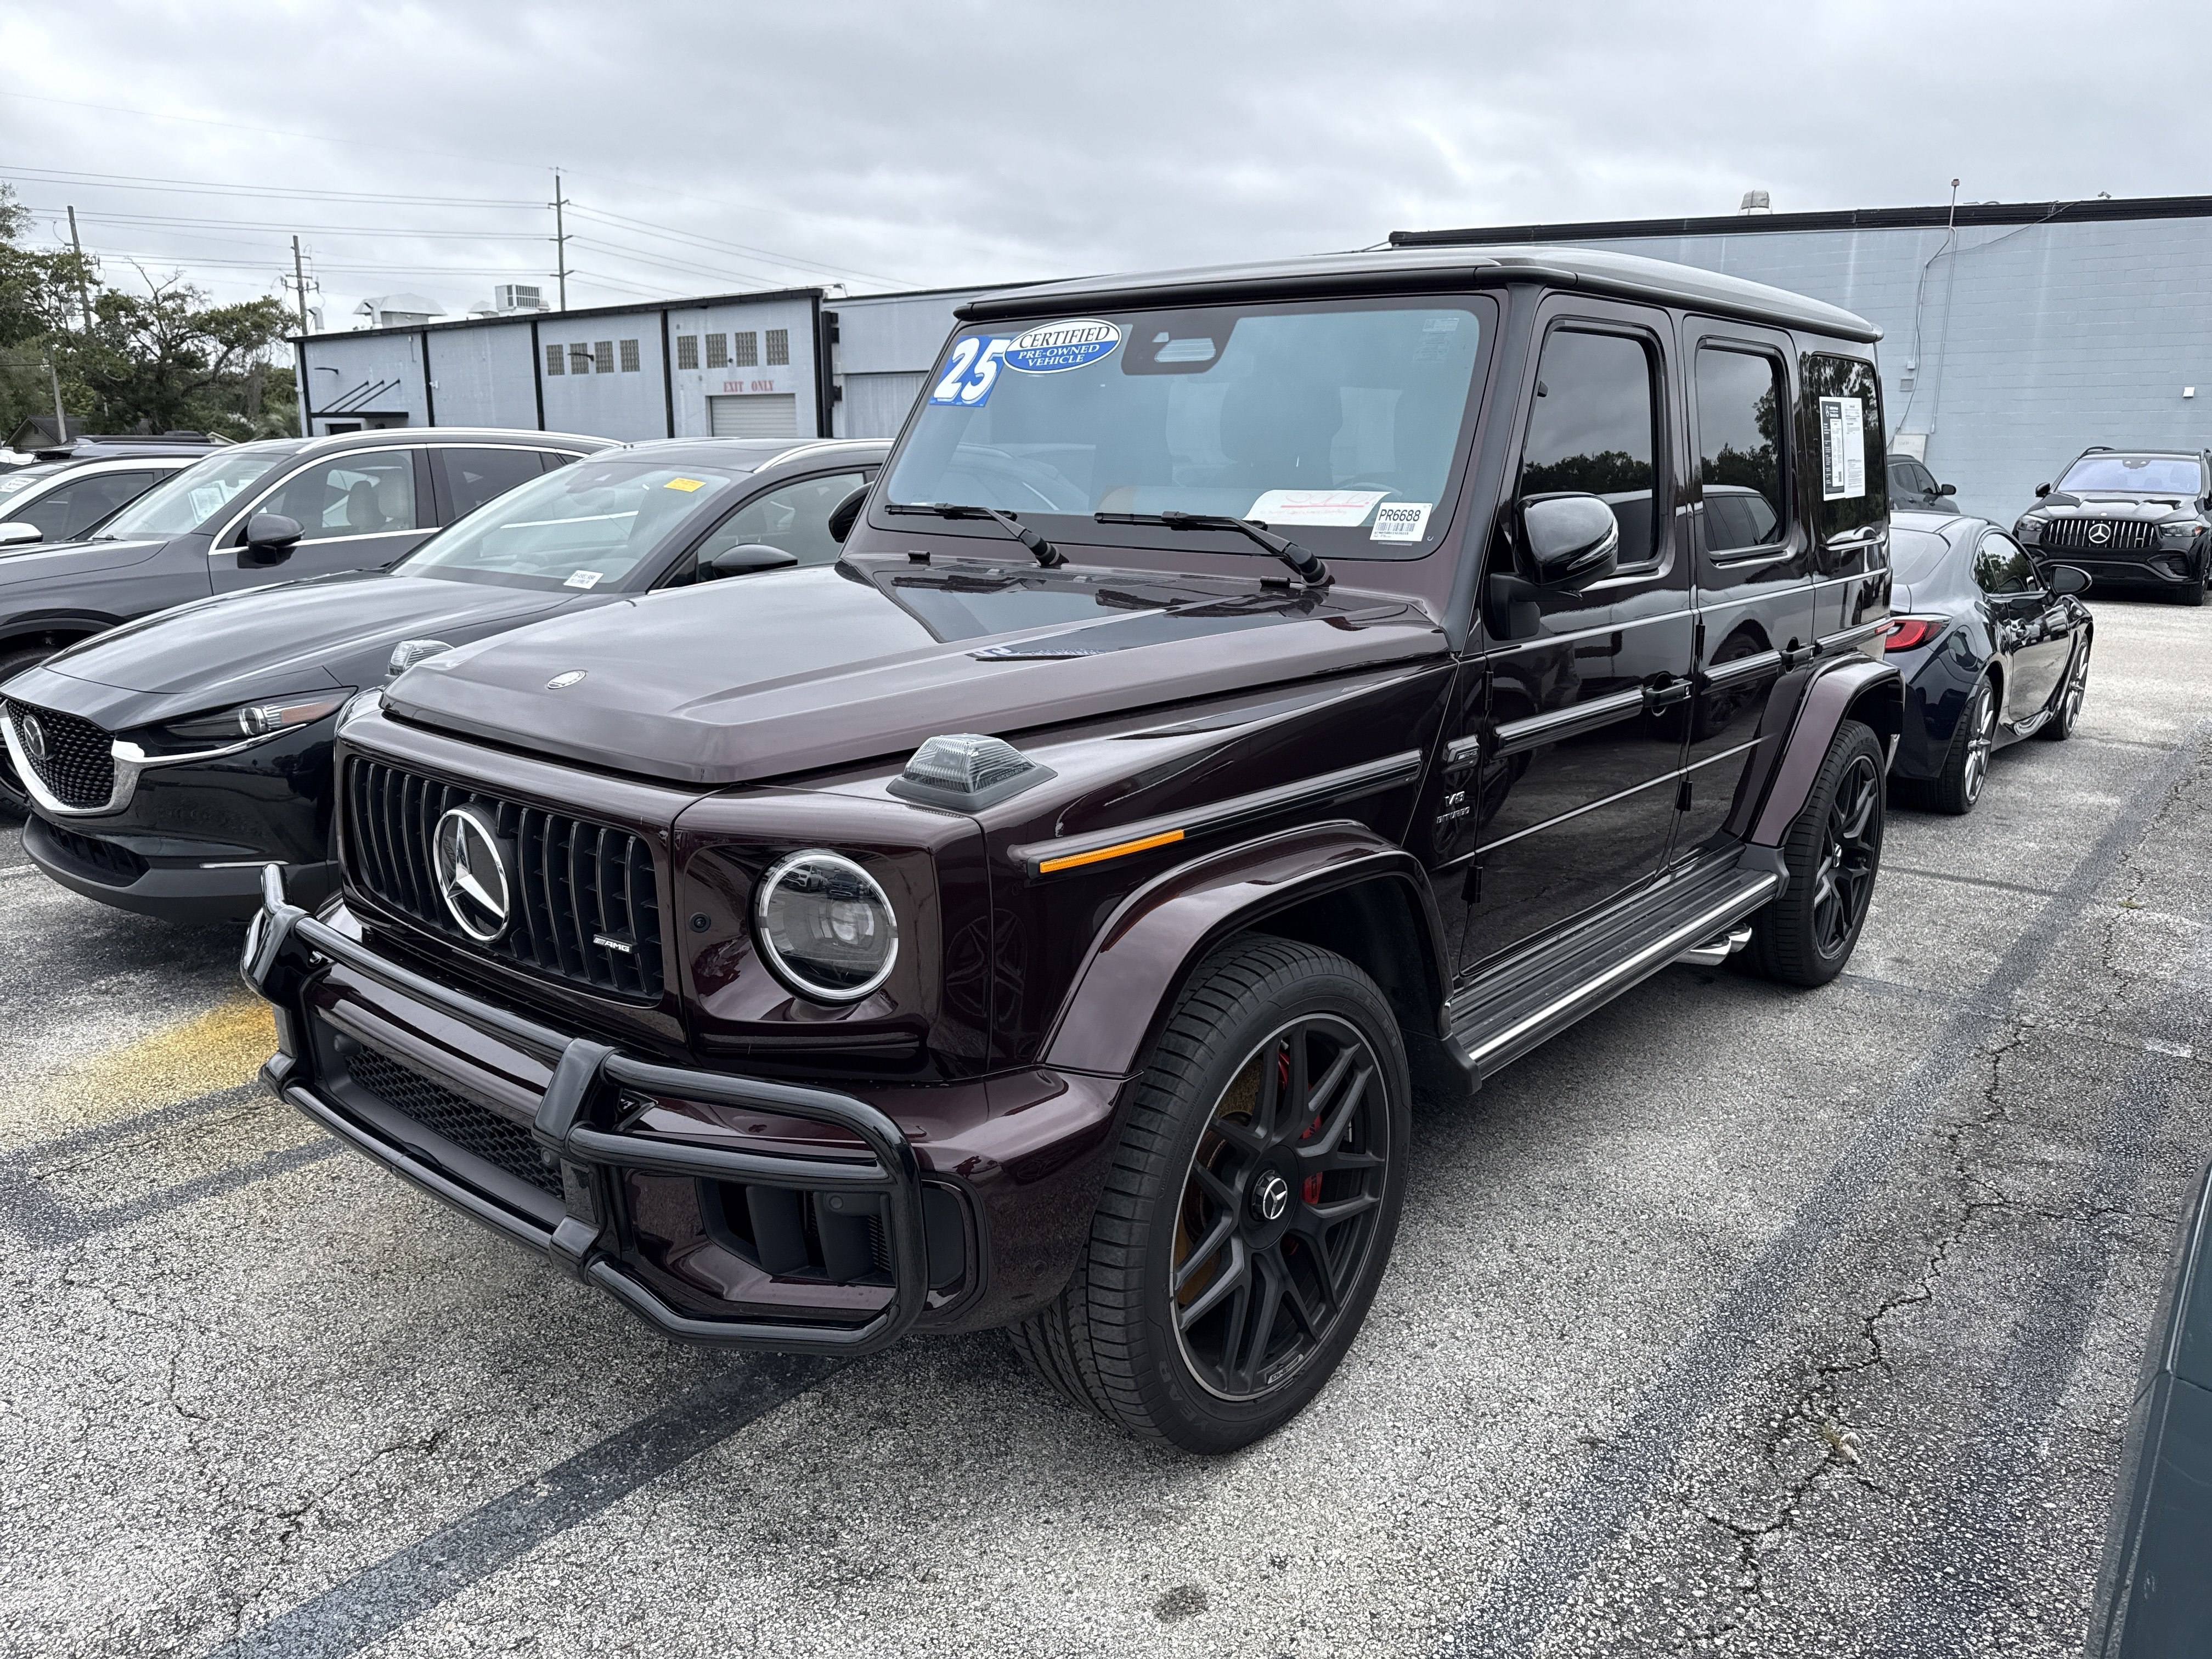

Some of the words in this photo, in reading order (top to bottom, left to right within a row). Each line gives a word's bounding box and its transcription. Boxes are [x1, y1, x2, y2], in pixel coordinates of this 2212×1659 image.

[1019, 326, 1110, 349] CERTIFIED
[1018, 344, 1099, 360] PRE-OWNED
[1028, 354, 1084, 367] VEHICLE
[933, 336, 1012, 402] 25
[724, 381, 743, 392] EXIT
[752, 380, 774, 391] ONLY
[1379, 509, 1421, 522] PR6688
[1444, 791, 1465, 807] V8
[1436, 806, 1470, 823] BITURBO
